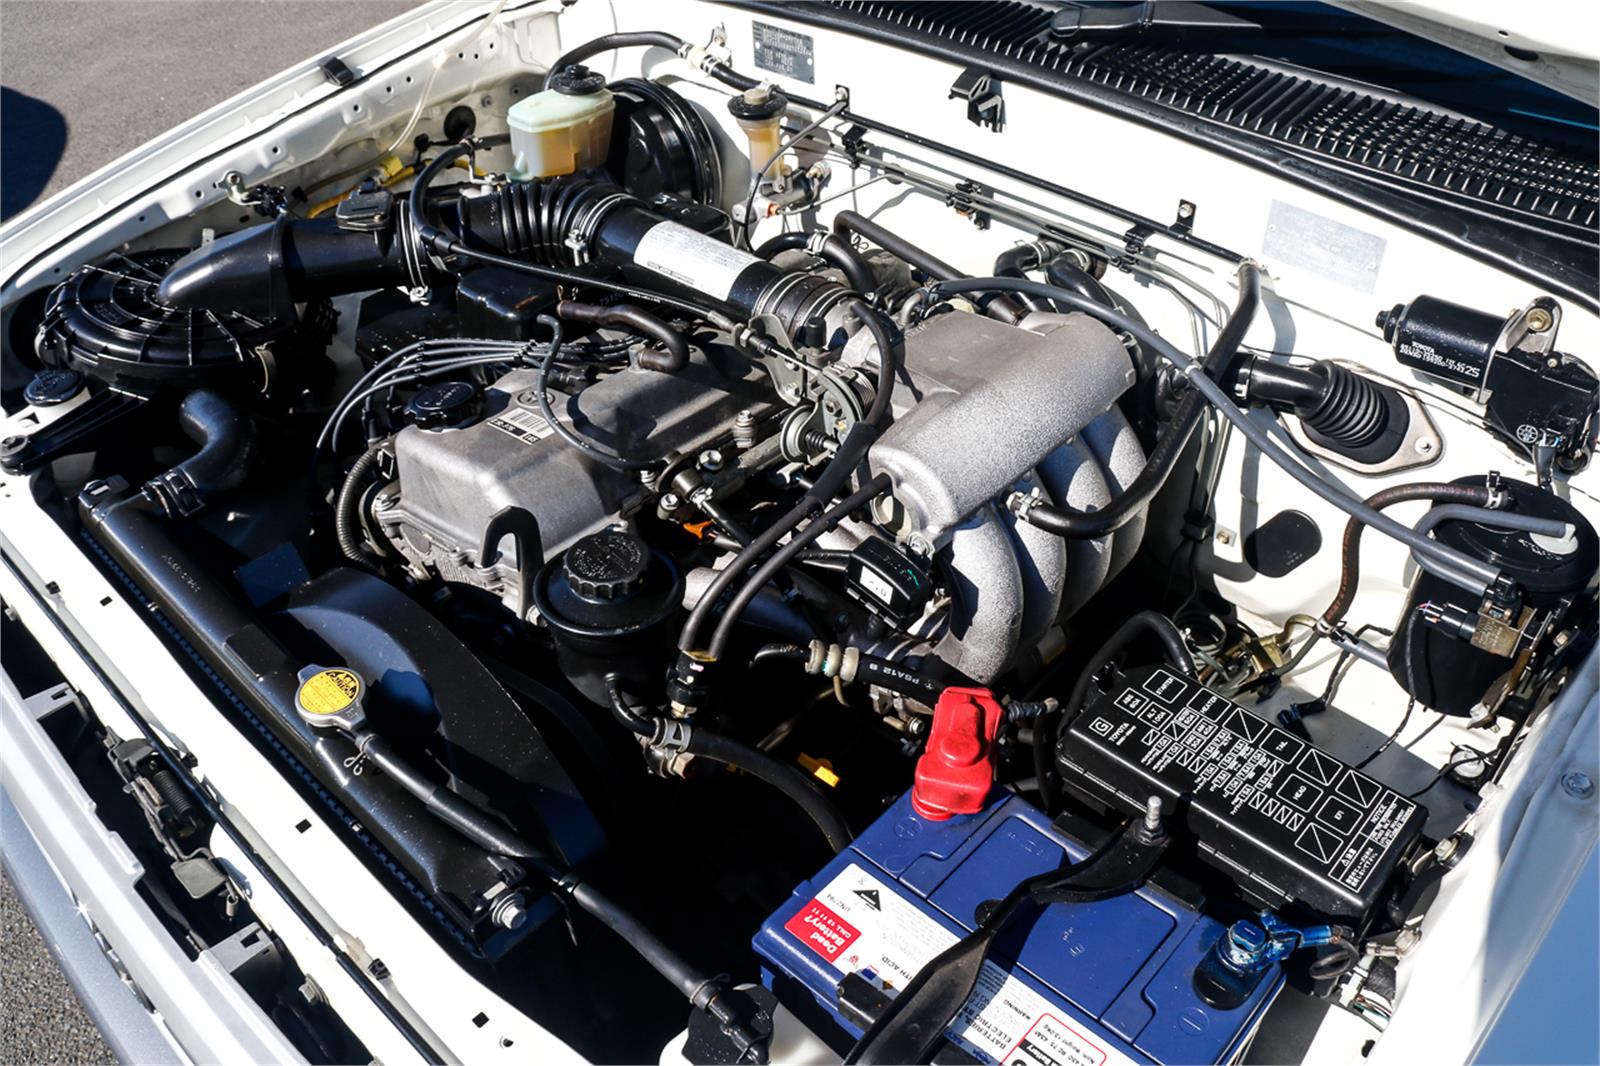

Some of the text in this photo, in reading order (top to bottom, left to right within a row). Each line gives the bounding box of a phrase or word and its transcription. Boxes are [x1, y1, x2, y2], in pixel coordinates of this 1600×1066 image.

[883, 667, 919, 684] PSA12
[1156, 676, 1175, 695] STARTER
[1201, 695, 1219, 714] HEATER
[1096, 719, 1109, 732] G
[1108, 722, 1129, 742] TOYOTA
[1293, 785, 1307, 800] HEAD
[1370, 804, 1387, 823] NOTICE
[804, 915, 845, 946] Battery?
[836, 925, 852, 938] CALL
[810, 931, 838, 954] Dead
[900, 970, 912, 980] ITH
